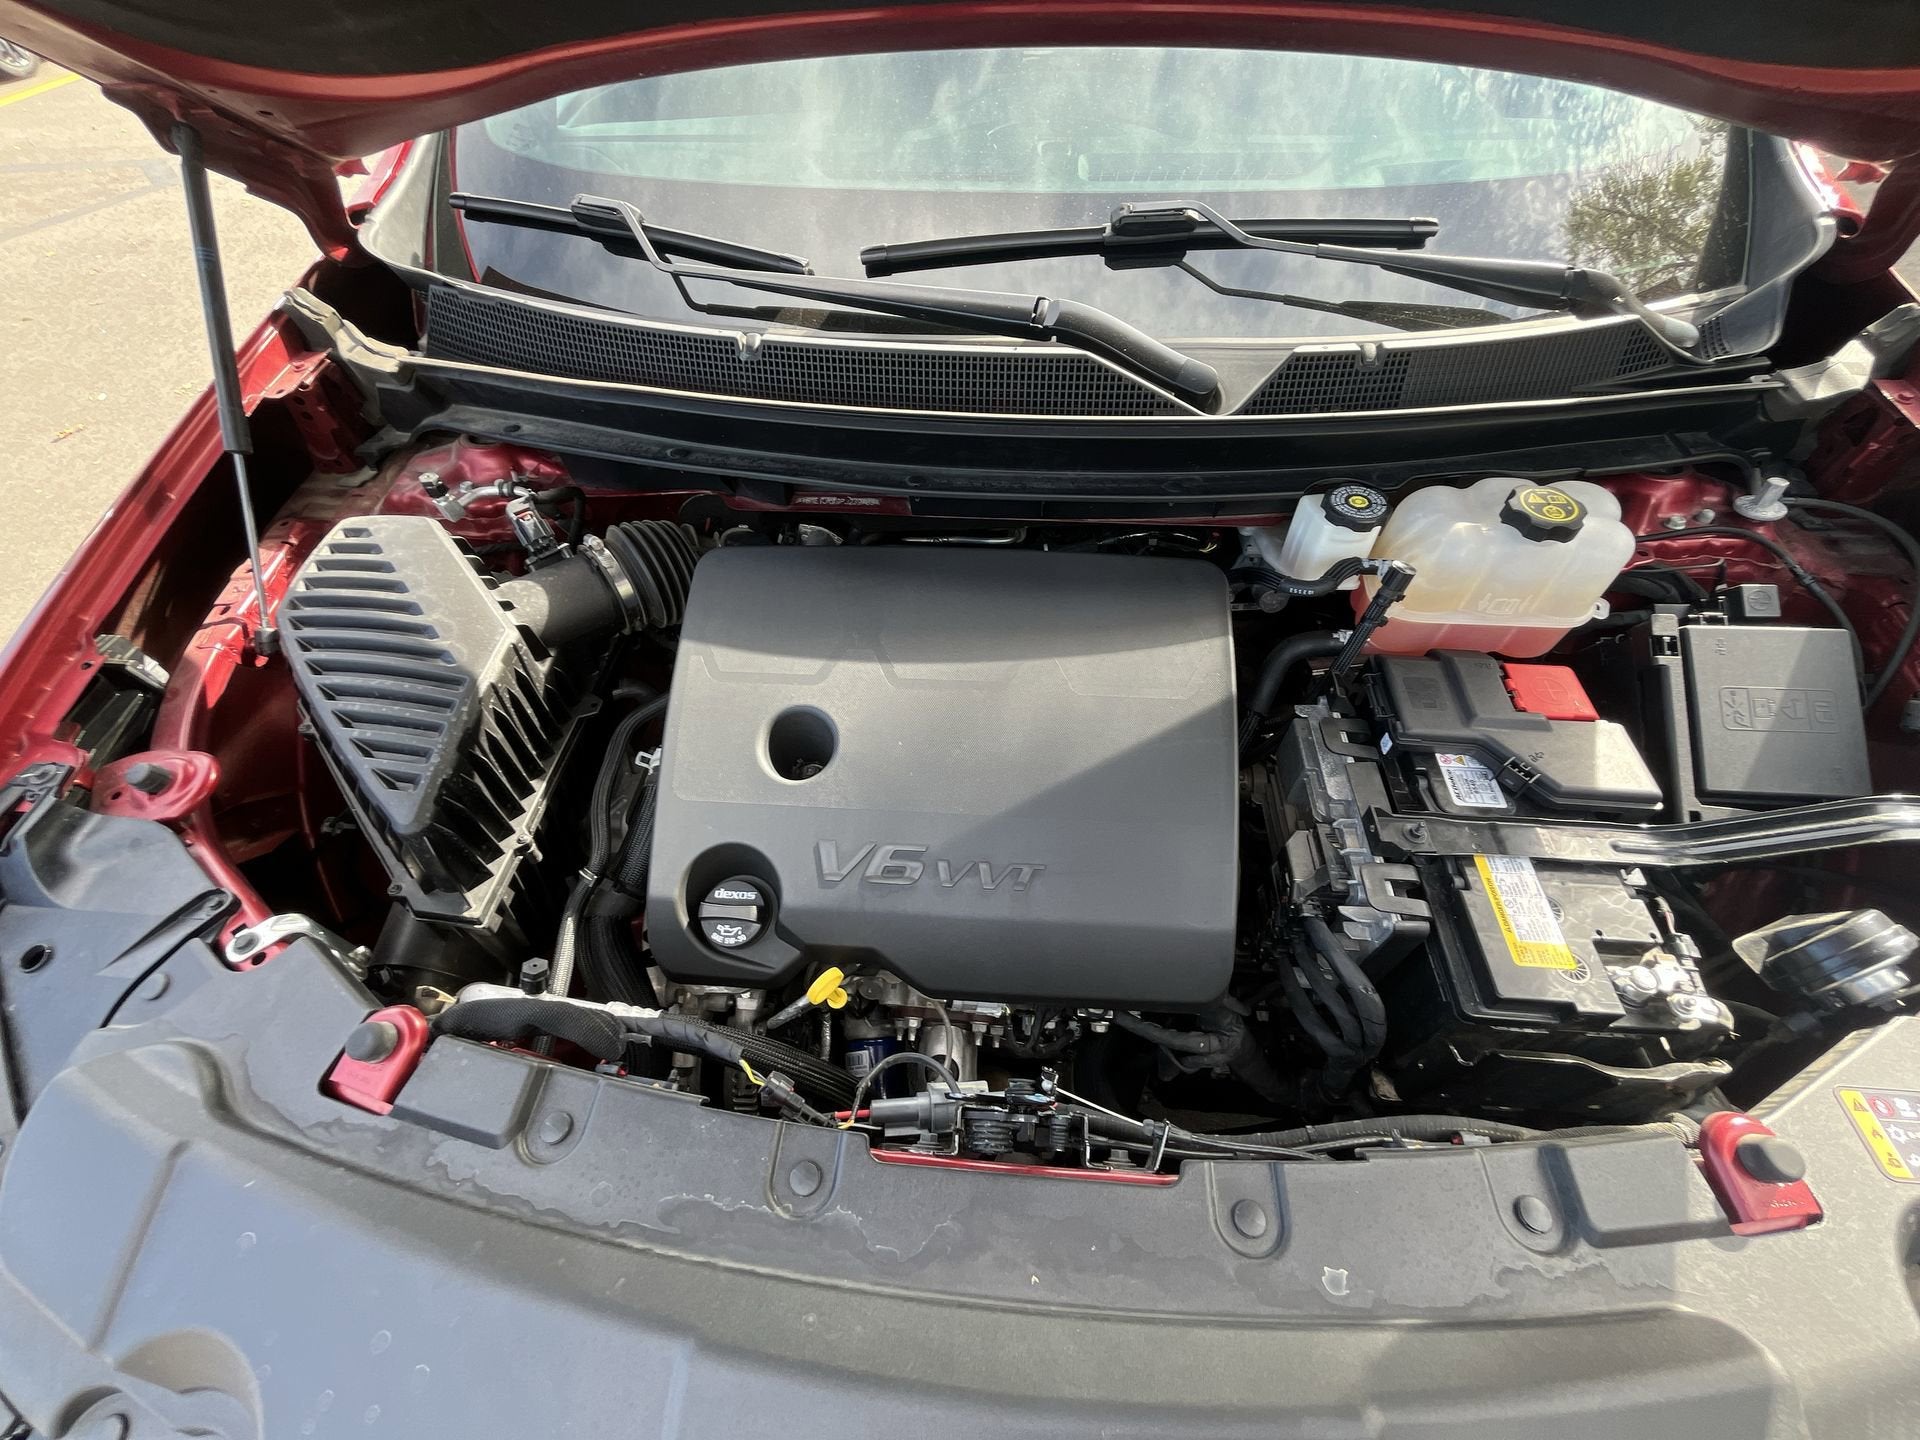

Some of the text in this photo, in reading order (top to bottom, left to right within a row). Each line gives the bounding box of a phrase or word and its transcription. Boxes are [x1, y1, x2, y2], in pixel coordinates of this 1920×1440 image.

[817, 840, 1047, 891] V6 VVT
[714, 888, 758, 899] dexos
